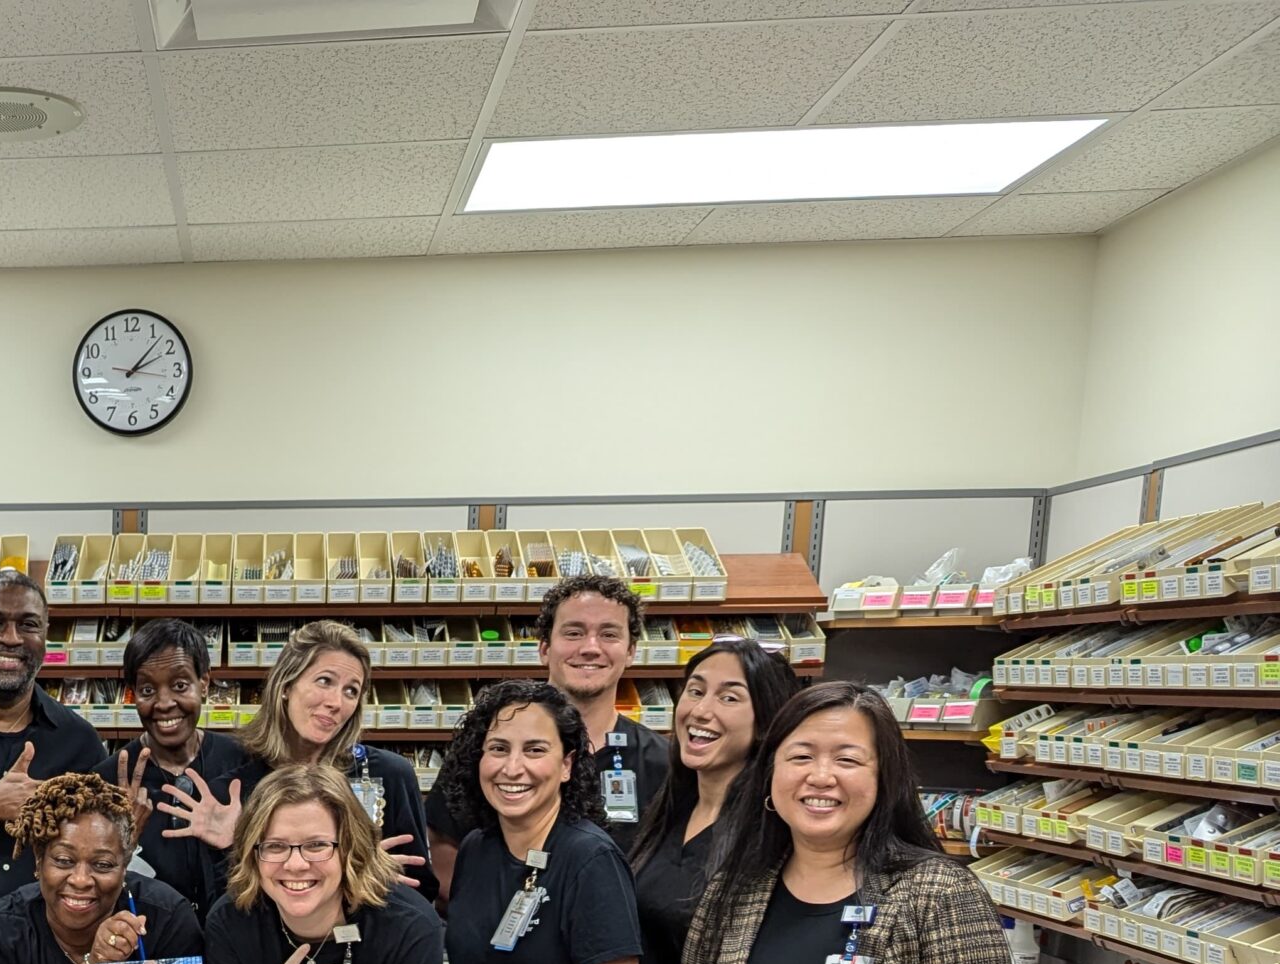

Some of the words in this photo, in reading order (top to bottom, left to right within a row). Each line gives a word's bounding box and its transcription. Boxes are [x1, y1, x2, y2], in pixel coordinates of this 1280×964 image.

[123, 316, 141, 332] 12
[150, 323, 157, 338] 1
[104, 326, 117, 341] 11
[85, 343, 100, 359] 10
[165, 339, 176, 355] 2
[81, 367, 91, 379] 9
[173, 362, 182, 378] 3
[106, 406, 117, 421] 7
[127, 410, 138, 426] 6
[149, 404, 159, 419] 5
